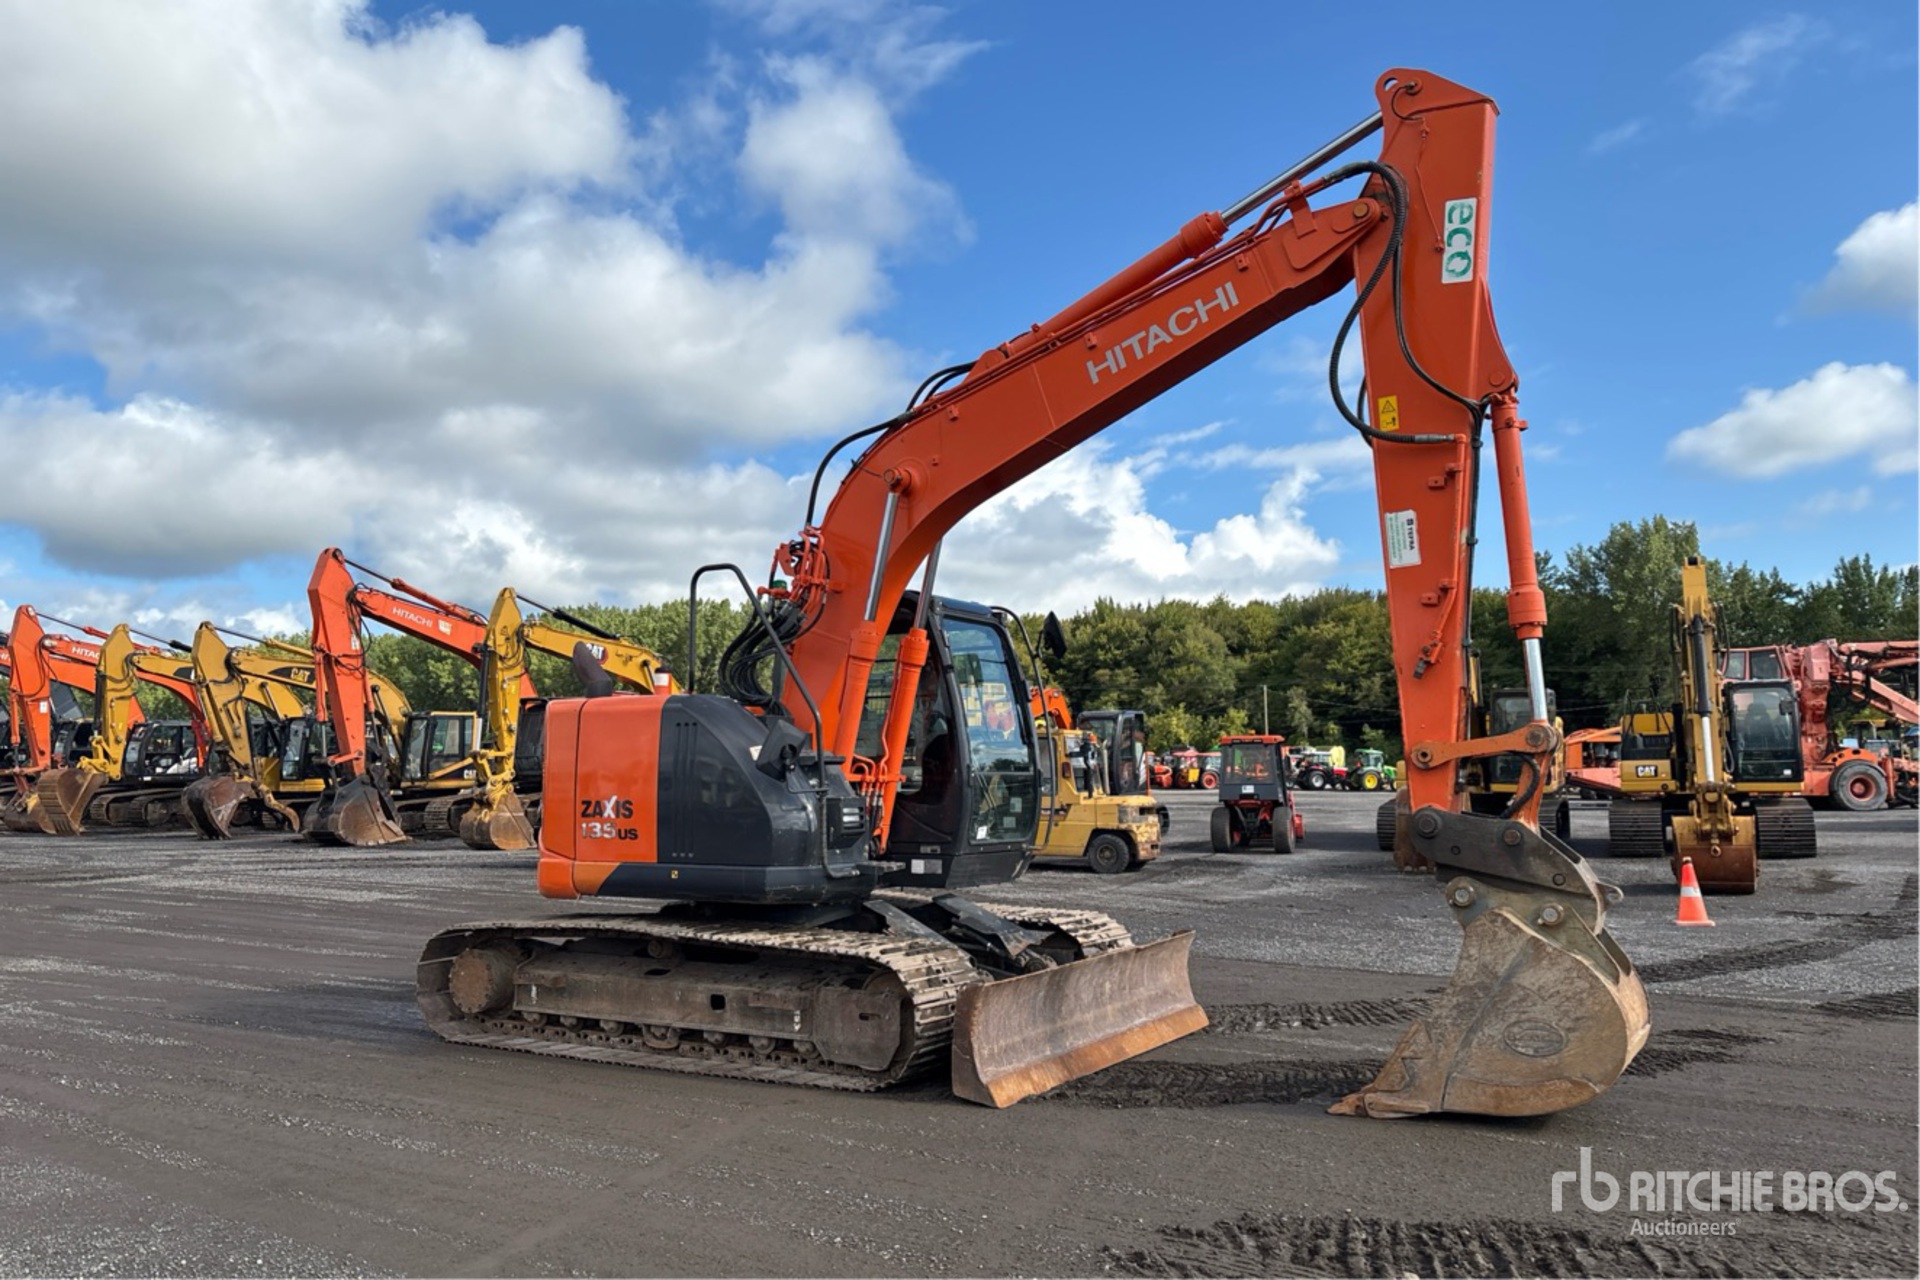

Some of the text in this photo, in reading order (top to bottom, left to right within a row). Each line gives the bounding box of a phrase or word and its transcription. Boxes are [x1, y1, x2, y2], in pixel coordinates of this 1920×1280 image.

[1446, 202, 1474, 278] eco
[1086, 281, 1239, 385] HITACHI
[391, 606, 434, 628] HITACHI
[290, 667, 311, 683] CAT
[1637, 766, 1657, 778] CAT
[581, 795, 634, 819] ZAXIS
